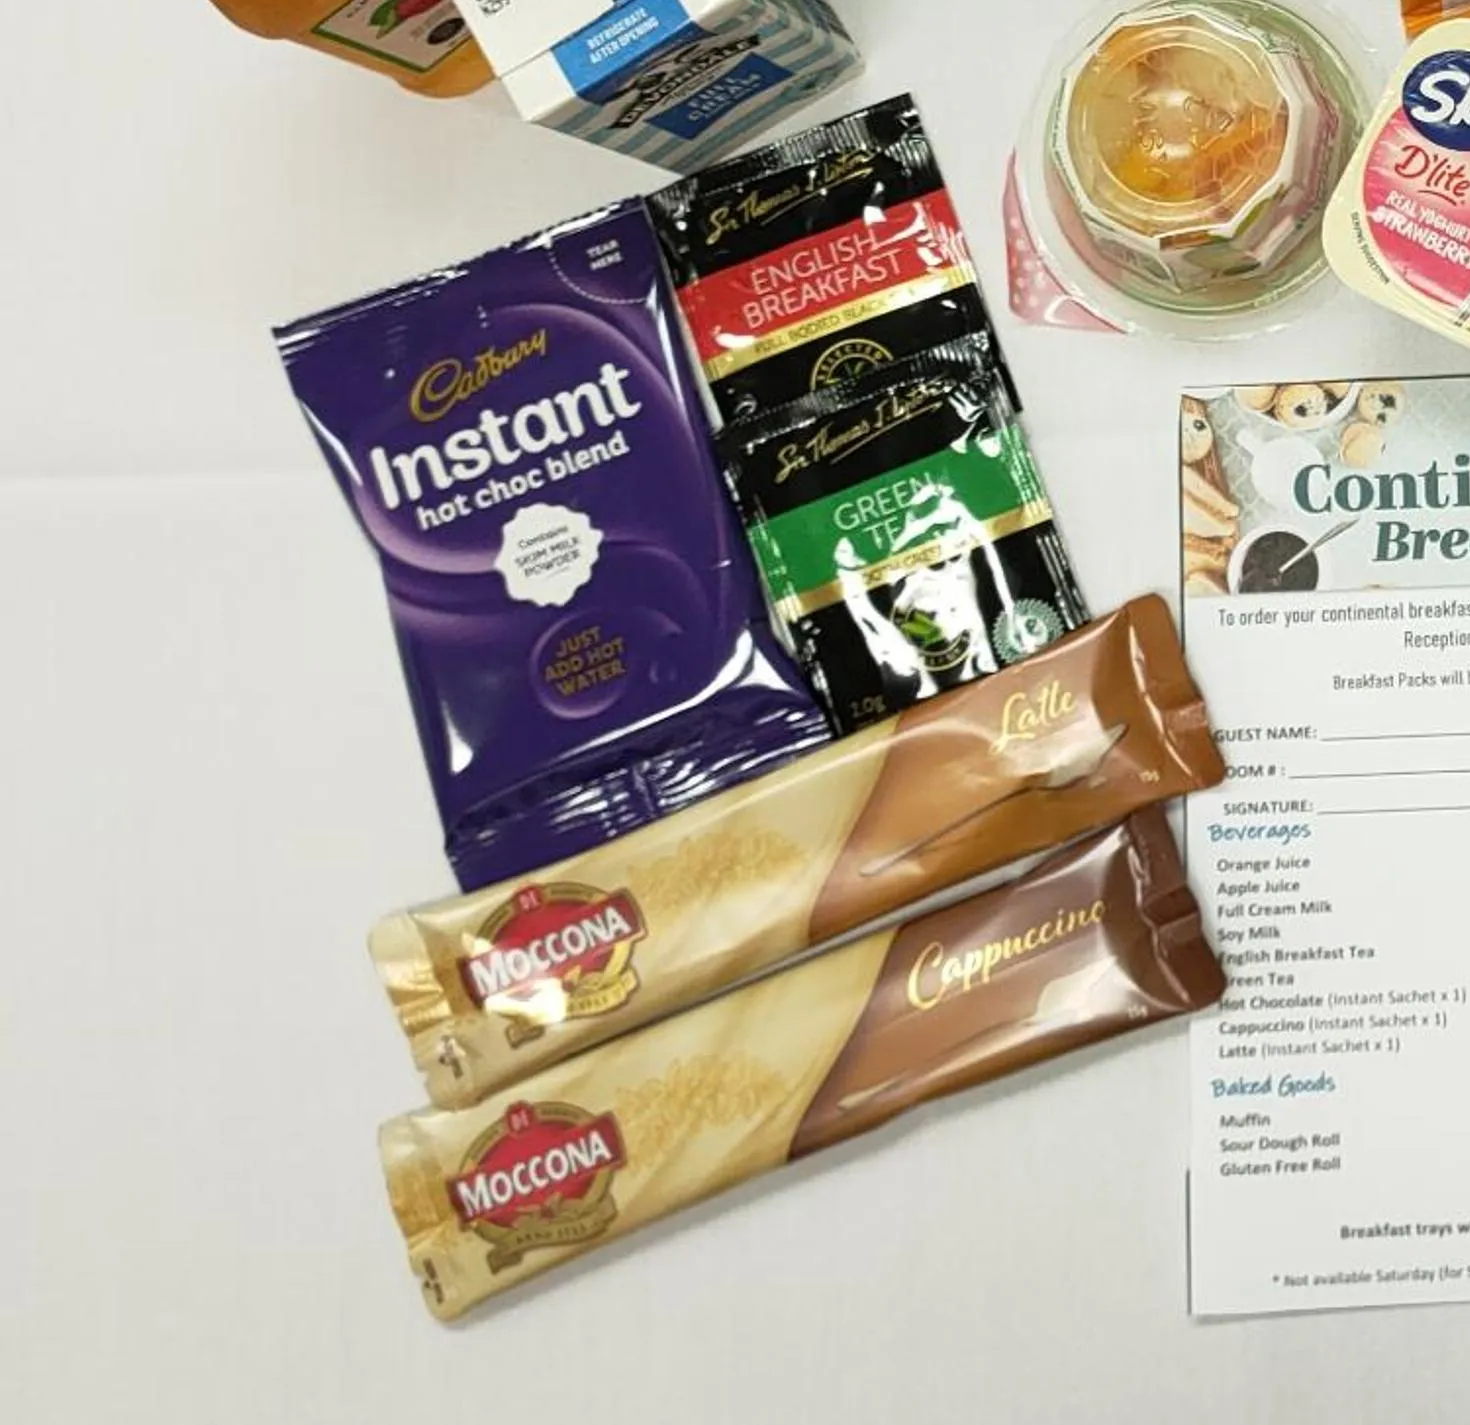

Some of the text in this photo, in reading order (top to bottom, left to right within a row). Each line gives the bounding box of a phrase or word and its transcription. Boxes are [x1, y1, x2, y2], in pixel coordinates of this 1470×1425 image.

[1385, 190, 1419, 220] REAL
[750, 229, 880, 294] ENGLISH
[742, 249, 903, 329] BREAKFAST
[408, 327, 548, 423] Cadbury
[369, 362, 643, 510] Instant
[415, 430, 631, 532] hot choc blend
[1219, 609, 1235, 626] To
[1239, 607, 1279, 626] order
[1284, 609, 1316, 628] your
[1321, 602, 1404, 624] continental
[555, 625, 600, 658] JUST
[545, 636, 626, 682] ADD HOT
[553, 661, 627, 699] WATER
[1333, 674, 1395, 690] Breakfast
[1399, 672, 1437, 688] Packs
[1440, 670, 1464, 686] will
[990, 680, 1075, 754] Latte
[1215, 726, 1317, 742] GUEST NAME:
[1225, 765, 1262, 779] OOM
[1223, 801, 1314, 816] SIGNATURE:
[1207, 823, 1311, 844] Beverages
[1217, 857, 1310, 873] Orange Juice
[1217, 881, 1300, 897] Apple Juice
[1218, 901, 1332, 918] Full Cream Milk
[1217, 927, 1280, 943] Soy Milk
[469, 905, 632, 998] MOCCONA
[907, 900, 1106, 1010] Cappuccino
[1275, 947, 1344, 962] Breakfast
[1349, 946, 1375, 959] Tea
[1230, 973, 1294, 987] reen Tea
[1212, 1071, 1336, 1097] Baked Goods
[456, 1130, 612, 1217] MOCCONA
